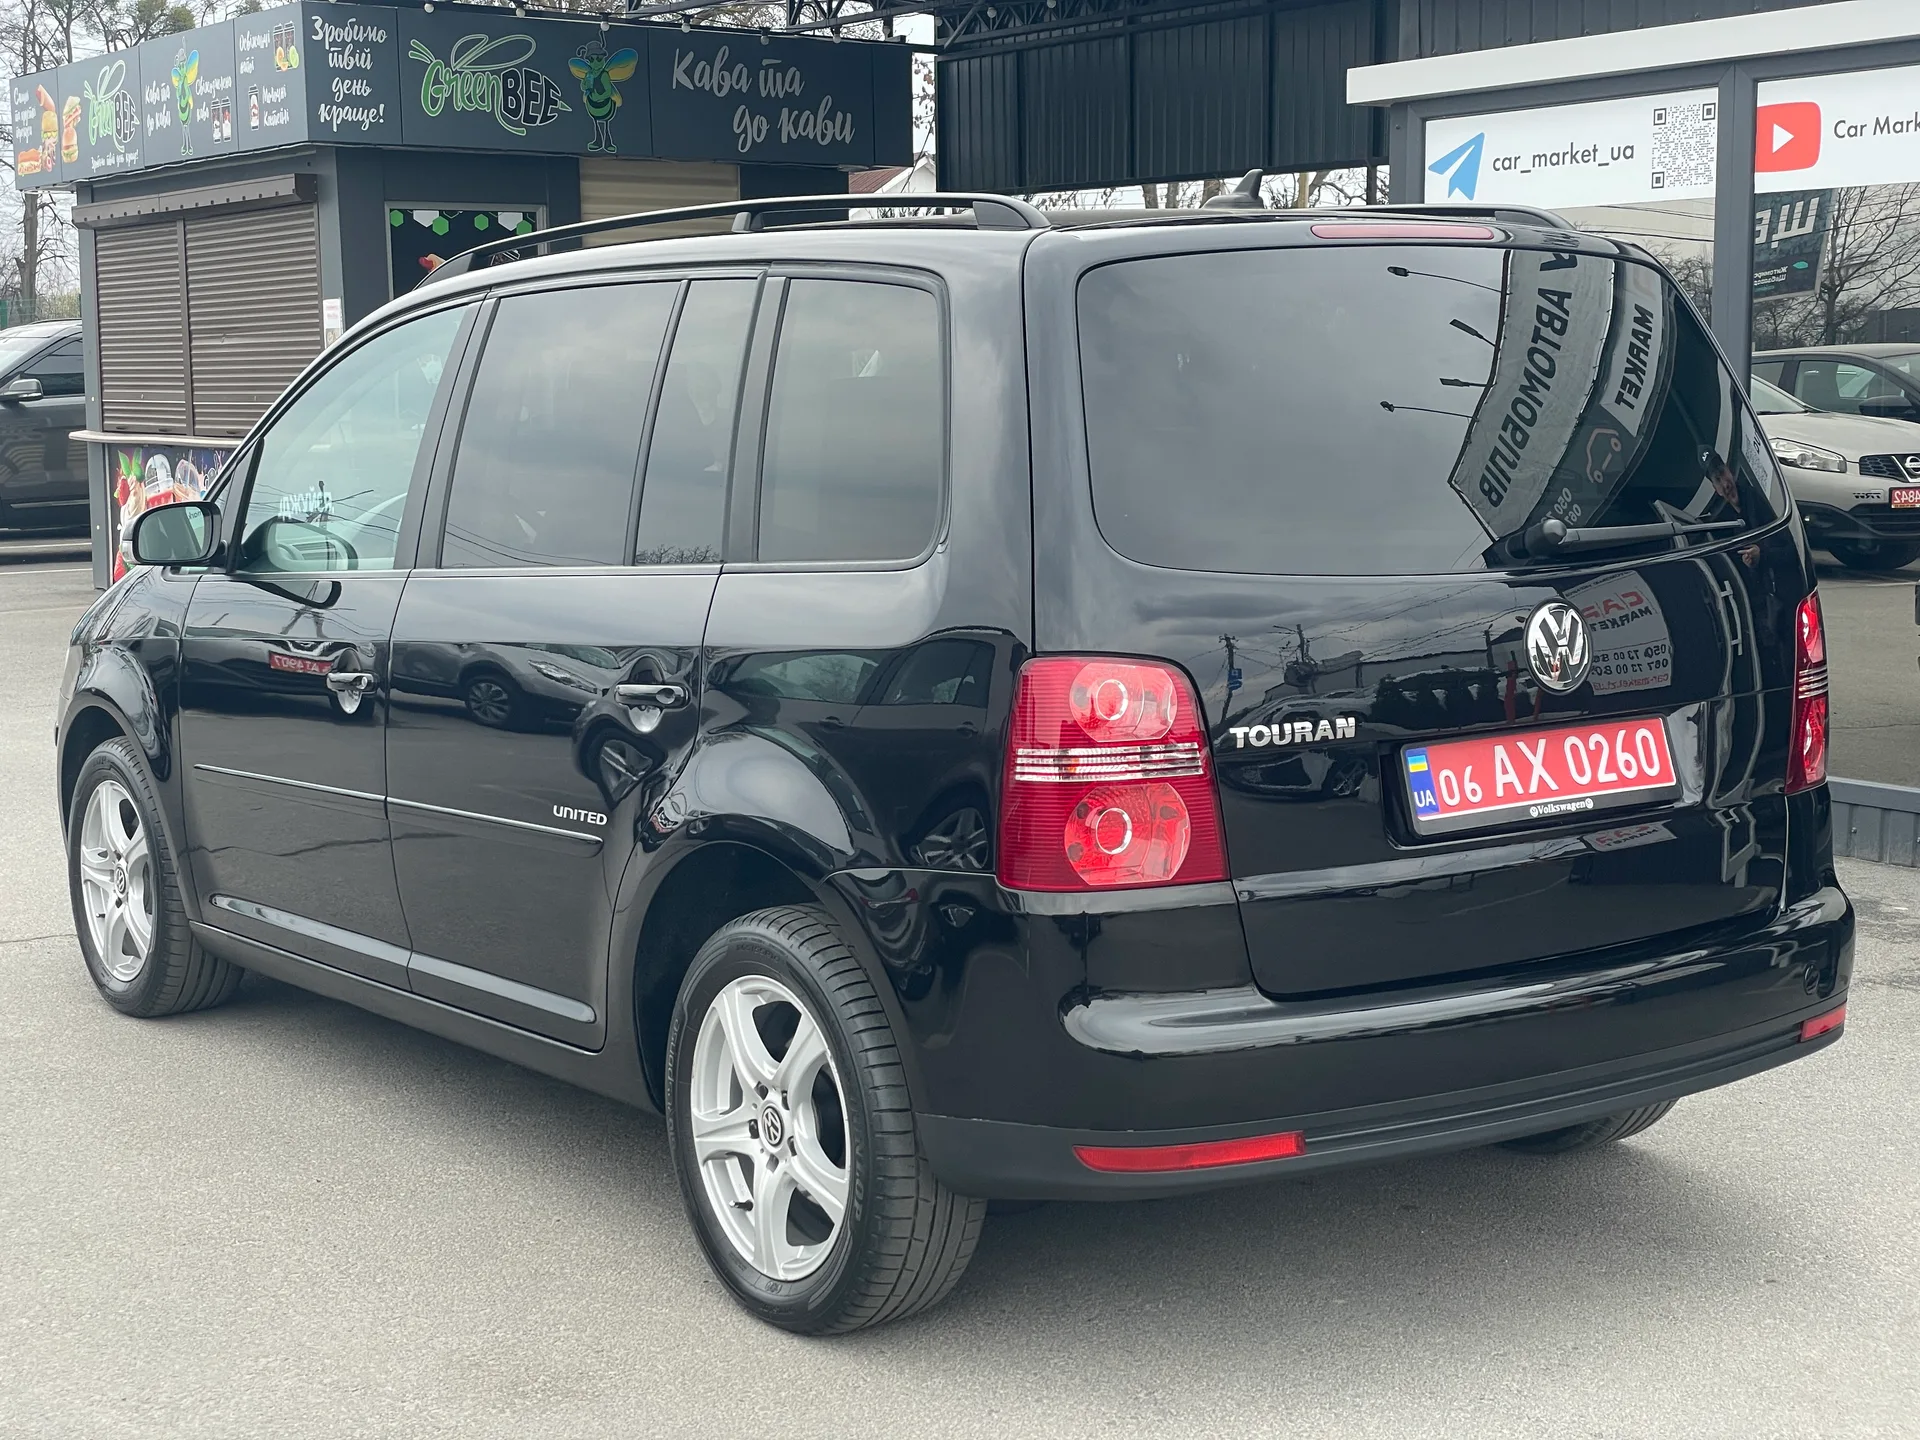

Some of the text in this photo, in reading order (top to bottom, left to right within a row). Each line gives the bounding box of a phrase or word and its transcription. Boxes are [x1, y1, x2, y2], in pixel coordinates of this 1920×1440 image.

[311, 15, 388, 50] Зробимо
[328, 43, 373, 70] твій
[672, 45, 805, 99] Кава та
[332, 77, 372, 102] день
[318, 103, 385, 132] краще!
[733, 95, 855, 153] до кави
[1833, 119, 1867, 139] Car
[1492, 141, 1635, 174] car_market_ua
[1229, 716, 1356, 749] TOURAN
[1438, 727, 1661, 807] 06 AX 0260
[553, 804, 608, 826] UNITED
[1414, 790, 1437, 809] UA
